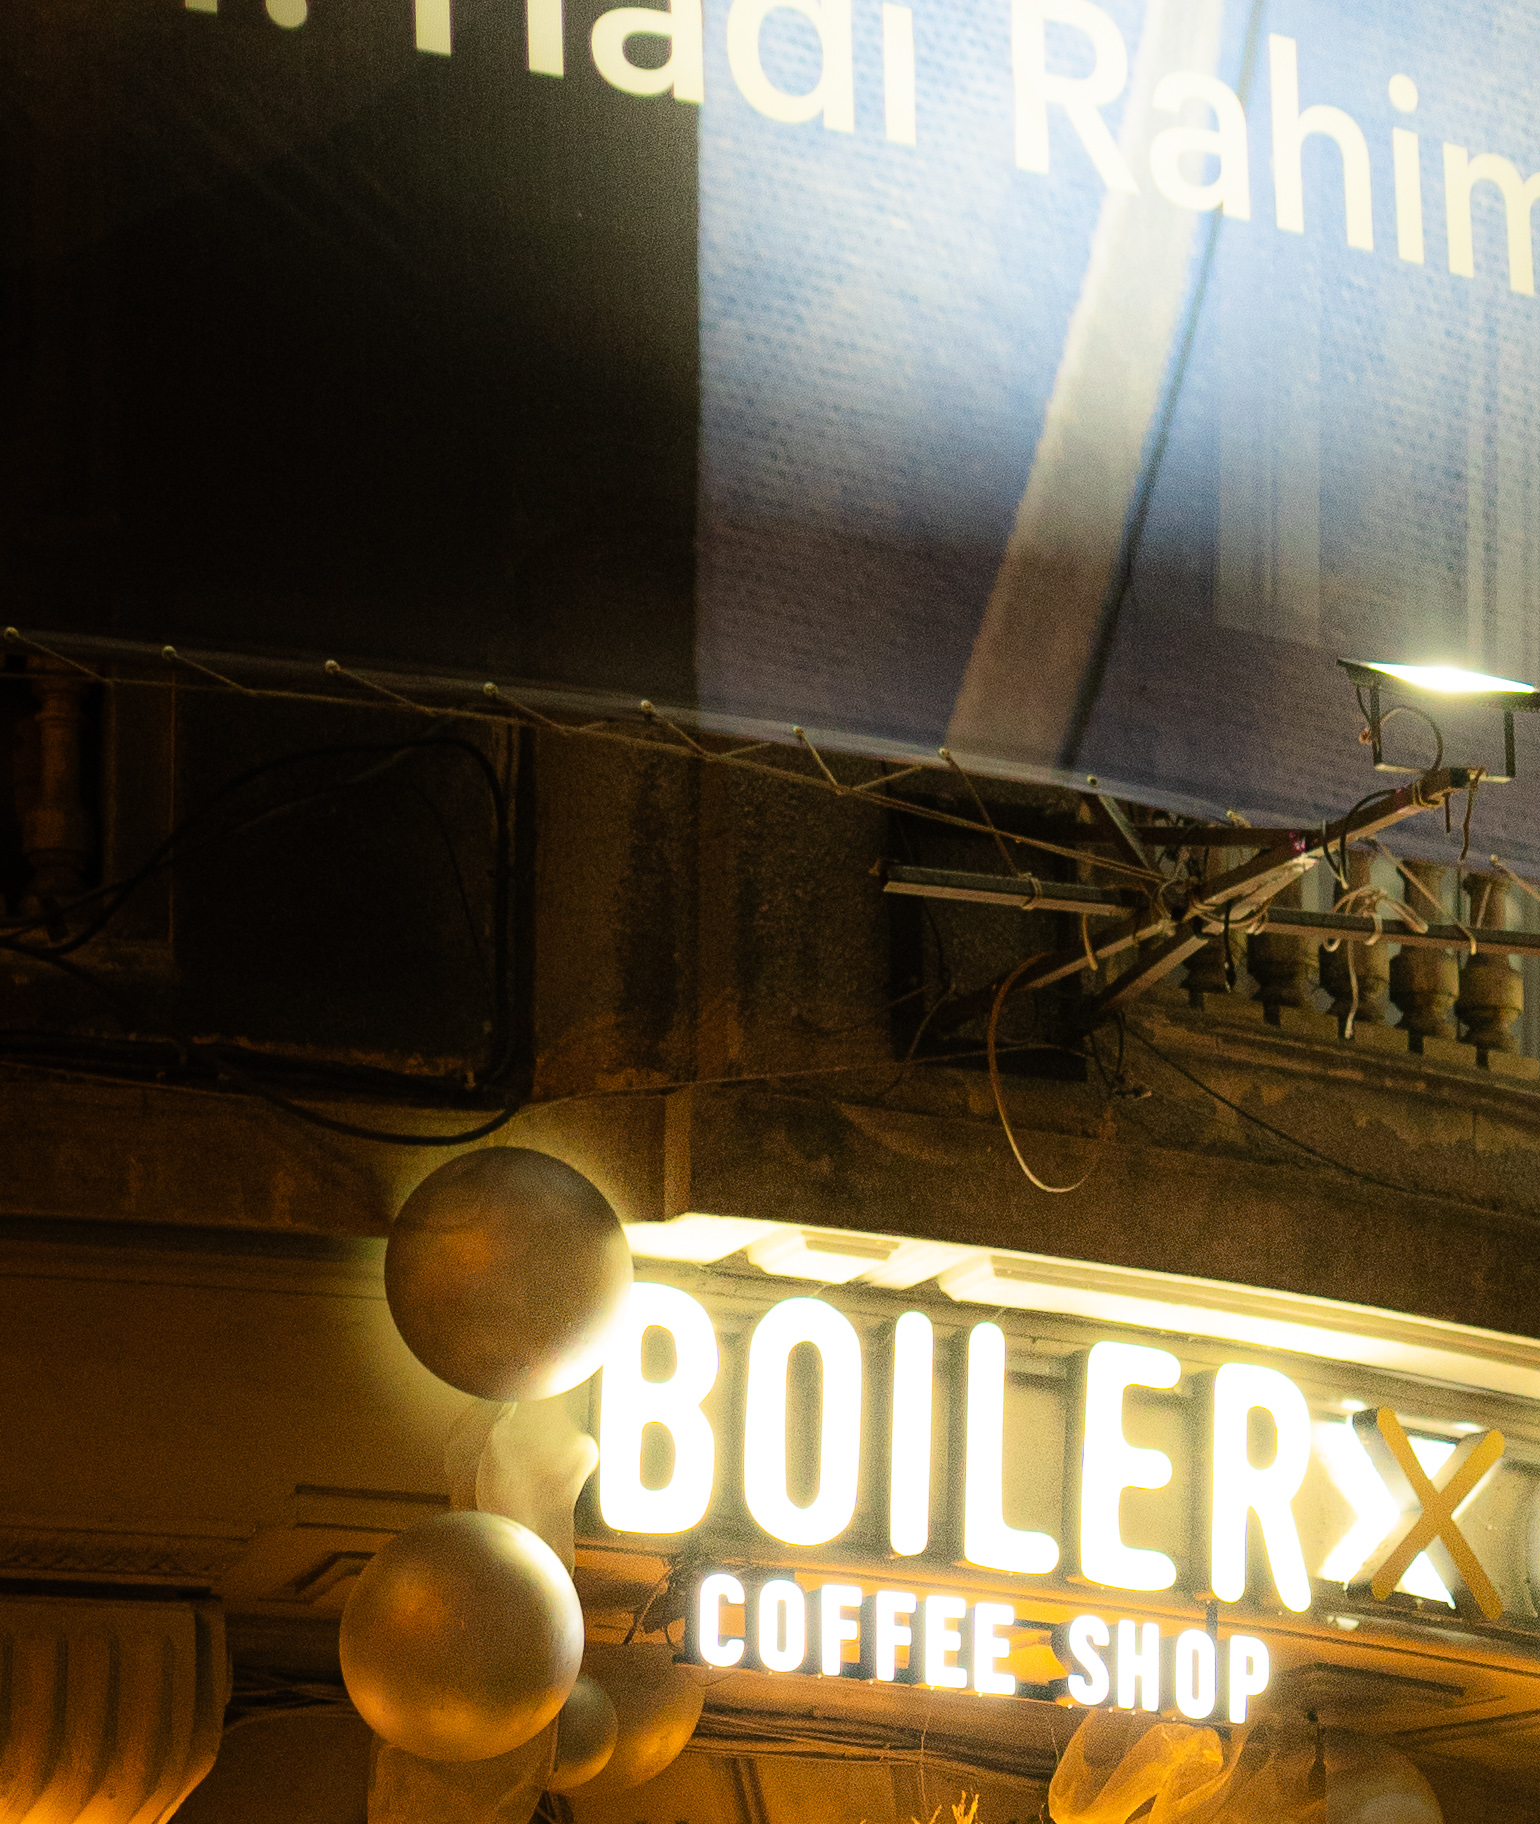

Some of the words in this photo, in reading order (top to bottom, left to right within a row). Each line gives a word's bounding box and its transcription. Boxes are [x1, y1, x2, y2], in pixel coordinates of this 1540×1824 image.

[598, 1282, 1313, 1613] BOILER
[698, 1573, 1018, 1696] COFFEE
[1067, 1615, 1270, 1724] SHOP
